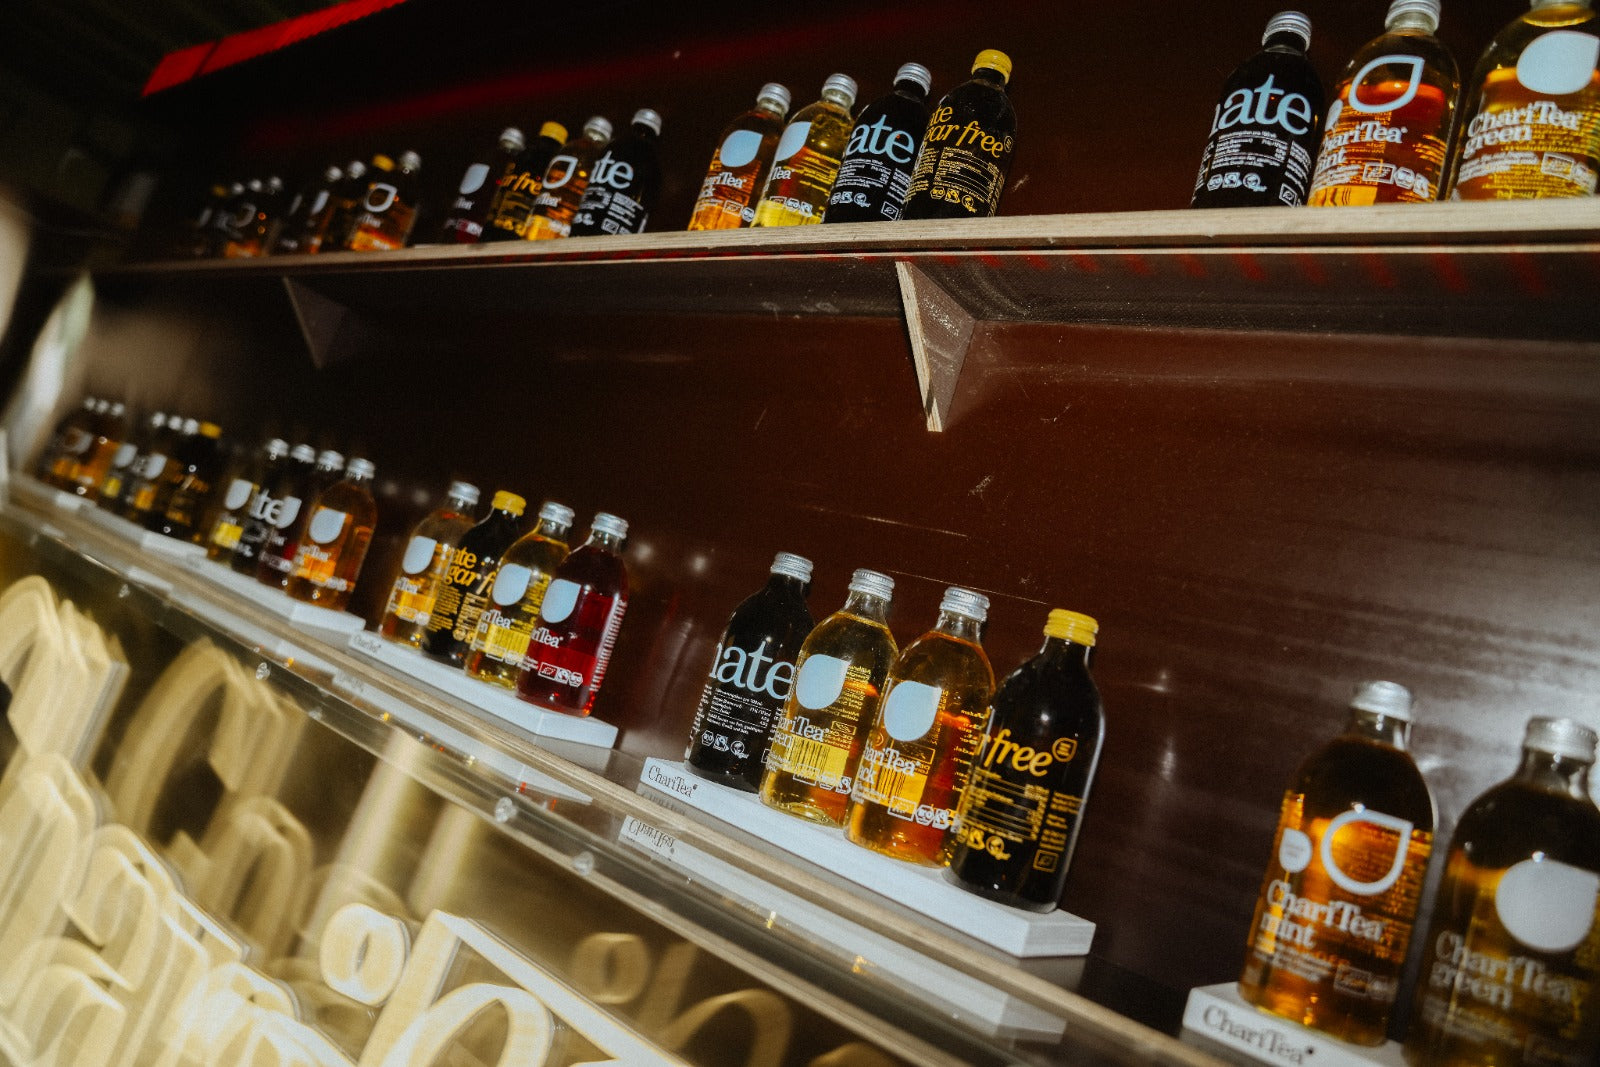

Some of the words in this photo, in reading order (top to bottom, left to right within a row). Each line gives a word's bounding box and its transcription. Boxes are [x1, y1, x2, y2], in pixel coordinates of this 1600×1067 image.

[955, 120, 1004, 158] free
[984, 728, 1053, 777] free
[648, 765, 693, 798] ChariTea
[1266, 879, 1386, 942] ChariTea
